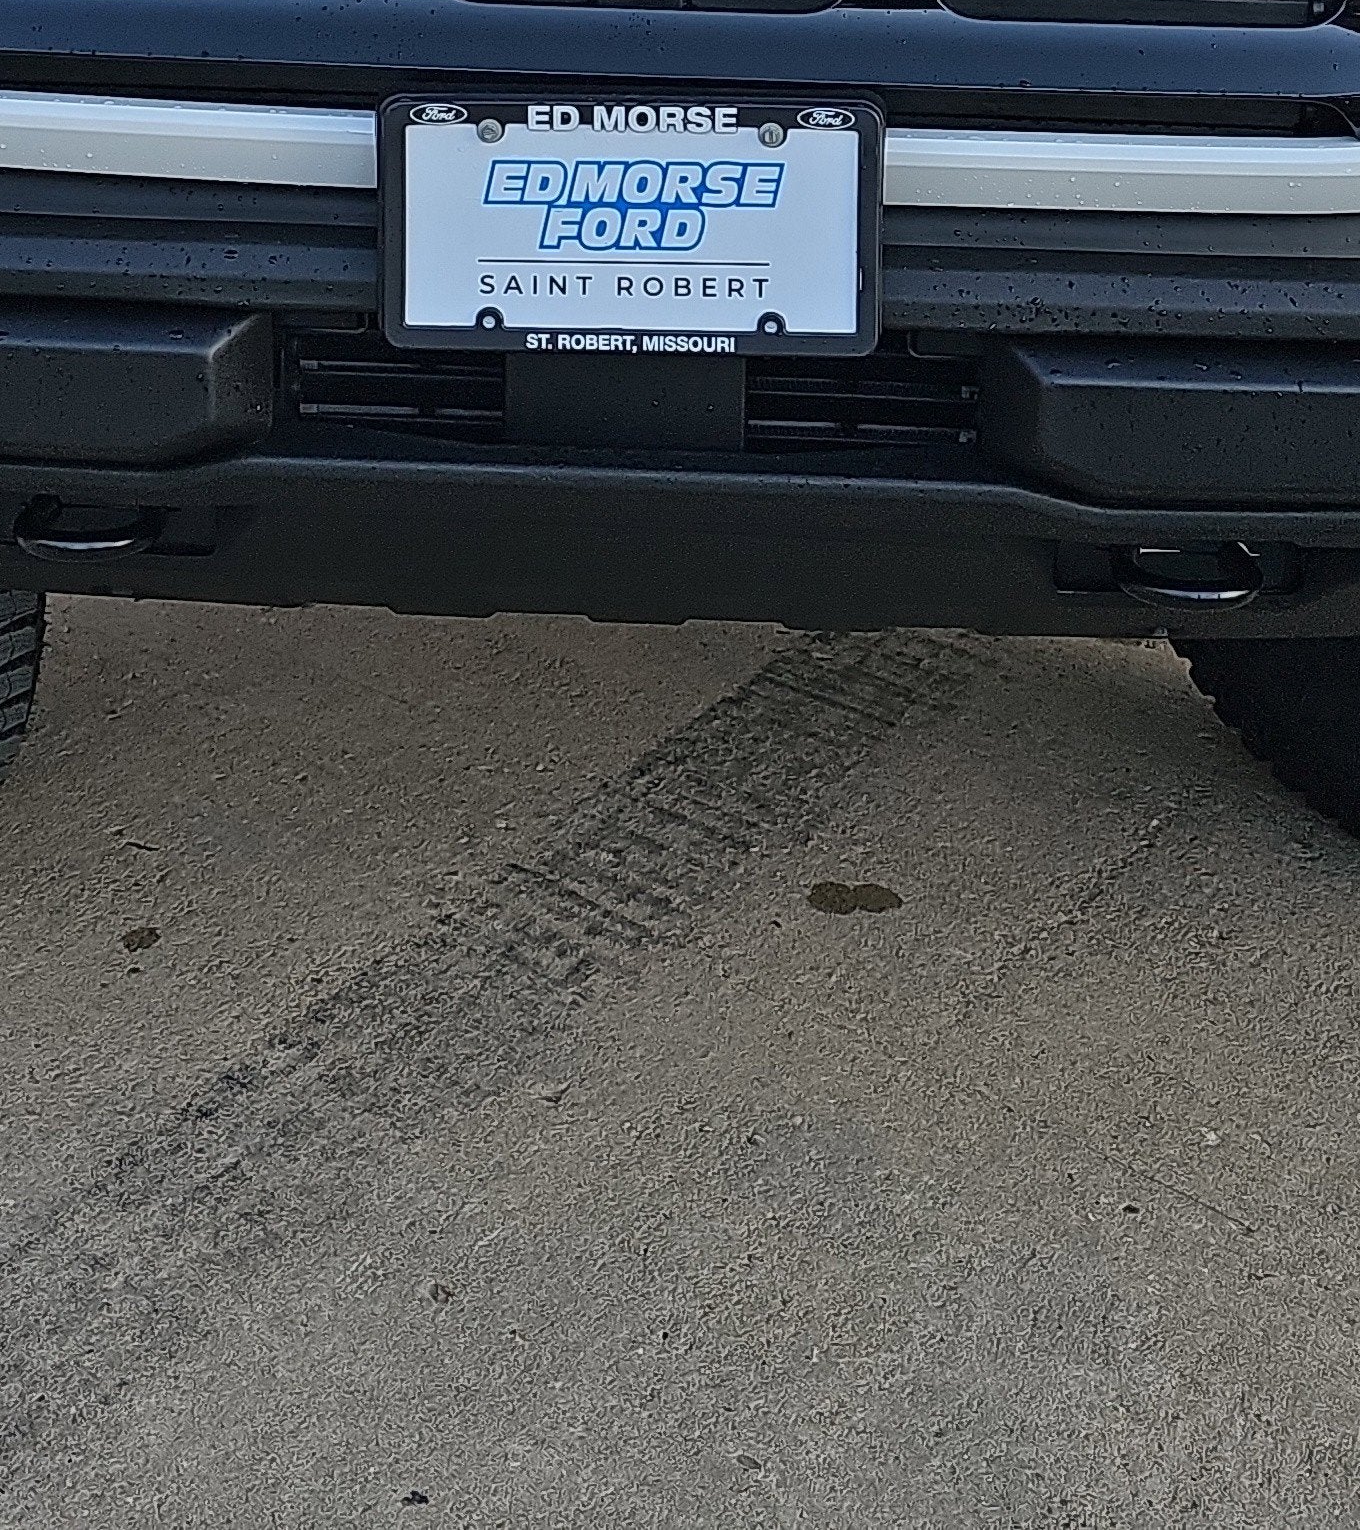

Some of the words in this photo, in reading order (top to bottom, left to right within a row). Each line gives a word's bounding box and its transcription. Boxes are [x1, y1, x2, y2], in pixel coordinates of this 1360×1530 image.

[421, 106, 457, 121] Ford
[526, 104, 580, 132] ED
[592, 105, 739, 133] MORSE
[808, 110, 844, 126] Ford
[483, 159, 569, 205] ED
[569, 159, 785, 208] MORSE
[539, 205, 706, 251] FORD
[479, 274, 594, 296] SAINT
[616, 276, 770, 298] ROBERT
[525, 333, 553, 350] ST.
[557, 334, 638, 354] ROBERT,
[642, 335, 736, 353] MISSOURI
